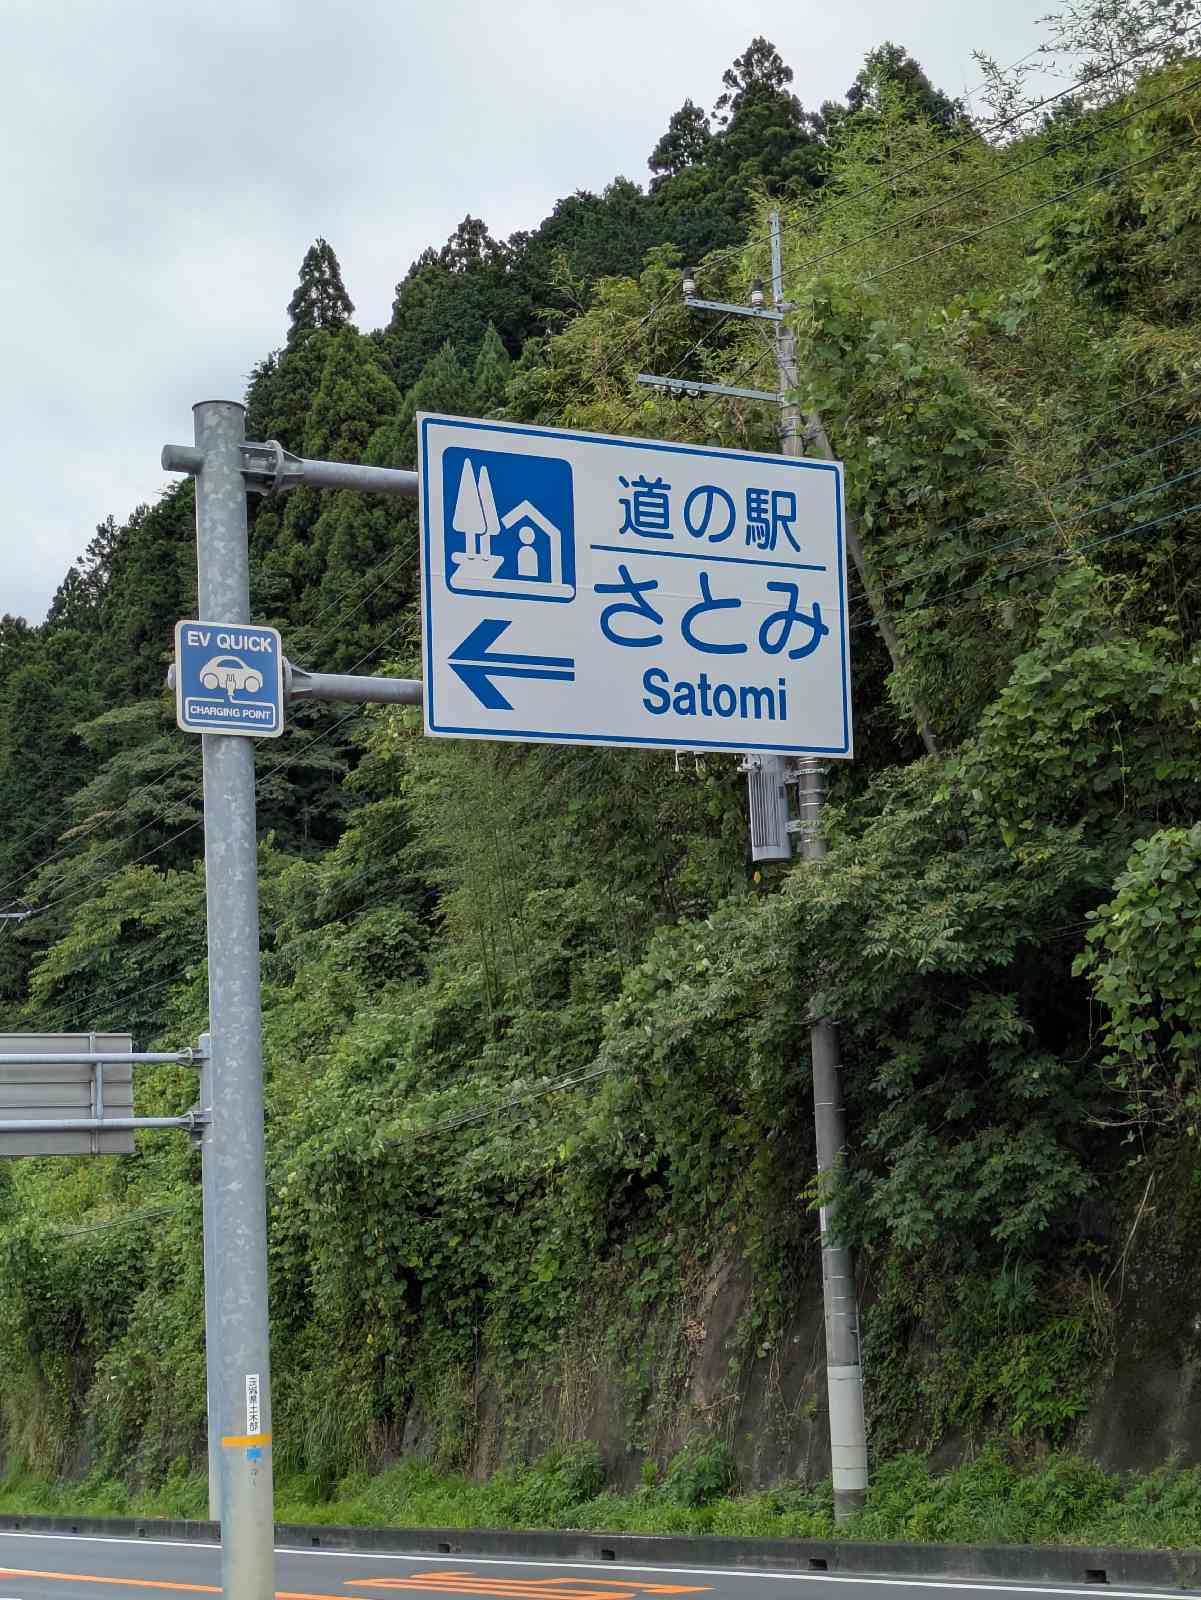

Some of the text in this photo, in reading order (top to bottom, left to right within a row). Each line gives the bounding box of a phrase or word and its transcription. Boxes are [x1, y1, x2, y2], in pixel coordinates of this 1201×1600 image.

[618, 475, 801, 553] 道の駅
[593, 564, 829, 660] さとみ
[187, 631, 272, 652] EV QUICK
[191, 706, 271, 720] CHARGING POINT
[642, 667, 787, 721] Satomi
